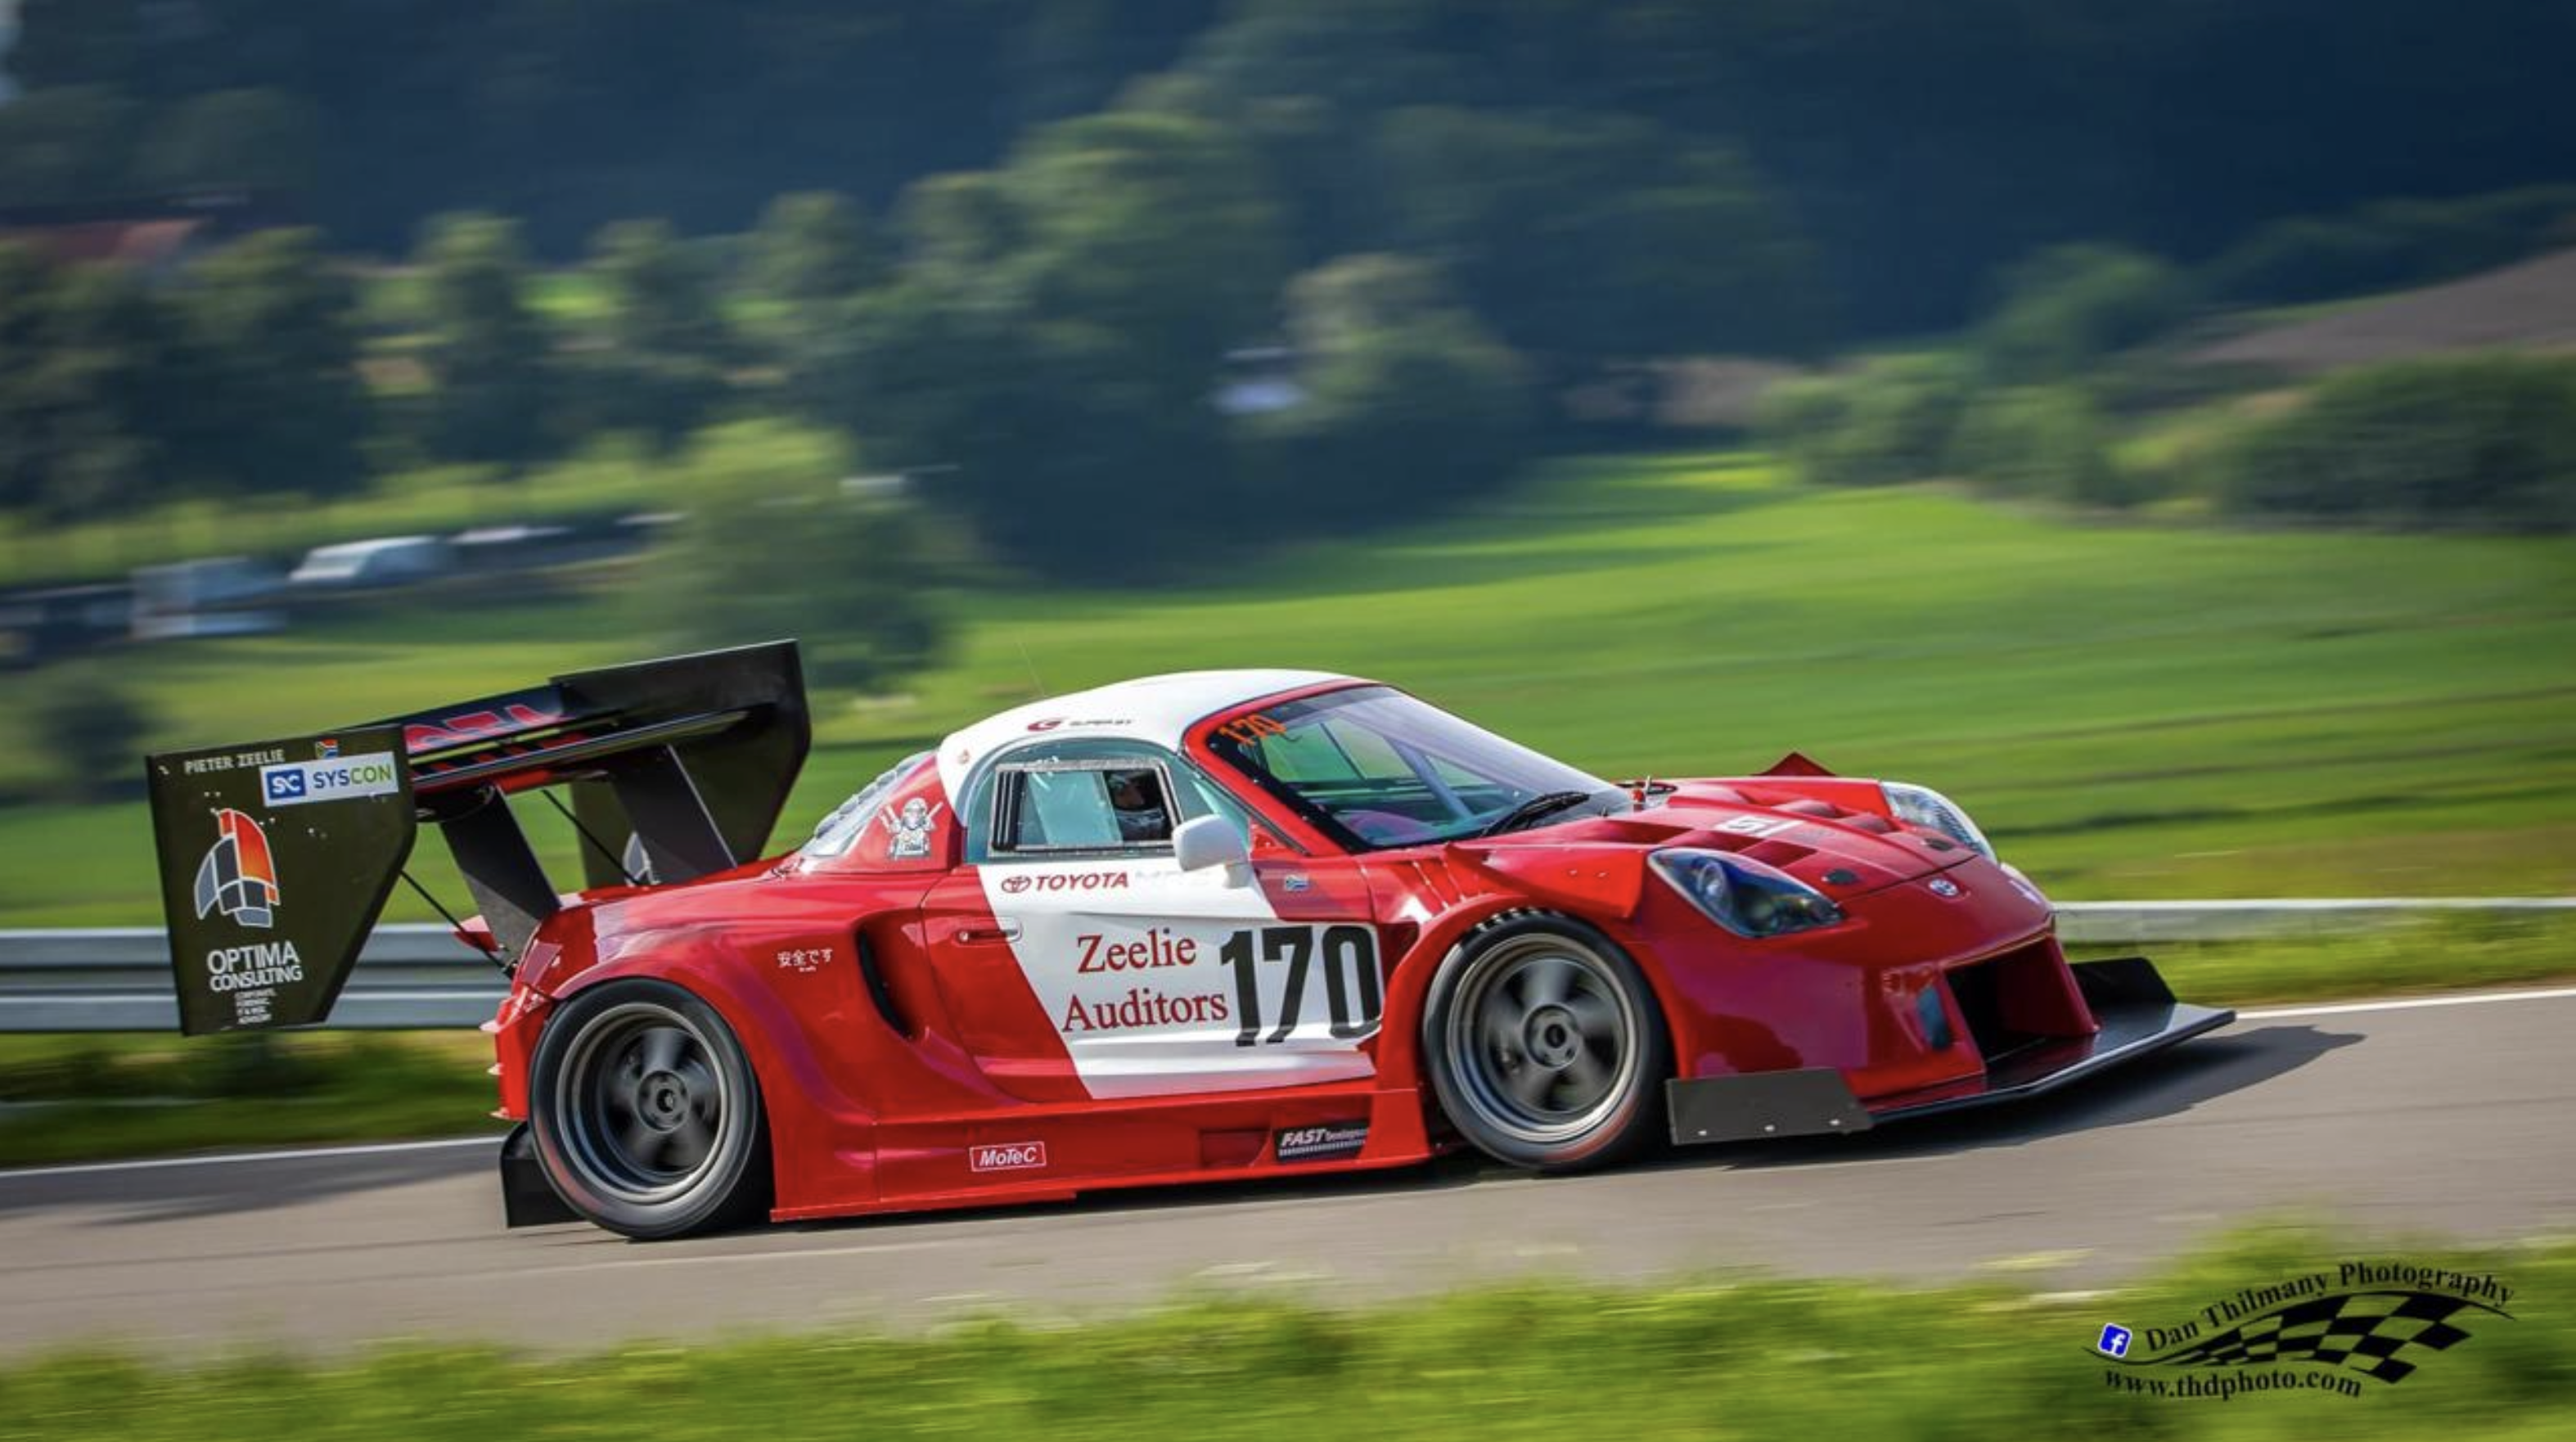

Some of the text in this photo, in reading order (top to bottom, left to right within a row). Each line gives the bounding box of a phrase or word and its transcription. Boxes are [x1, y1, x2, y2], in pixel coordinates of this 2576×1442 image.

[183, 748, 286, 775] PIETER ZEELIE
[313, 764, 392, 789] SYSCON
[1035, 872, 1129, 892] TOYOTA
[207, 940, 301, 975] OPTIMA
[777, 949, 833, 968] 安全です
[1077, 927, 1196, 974] Zeelie
[209, 965, 304, 992] CONSULTING
[1220, 925, 1383, 1048] 170
[1062, 988, 1228, 1033] Auditors
[1281, 1129, 1326, 1147] FAST
[979, 1147, 1037, 1167] MoTeC
